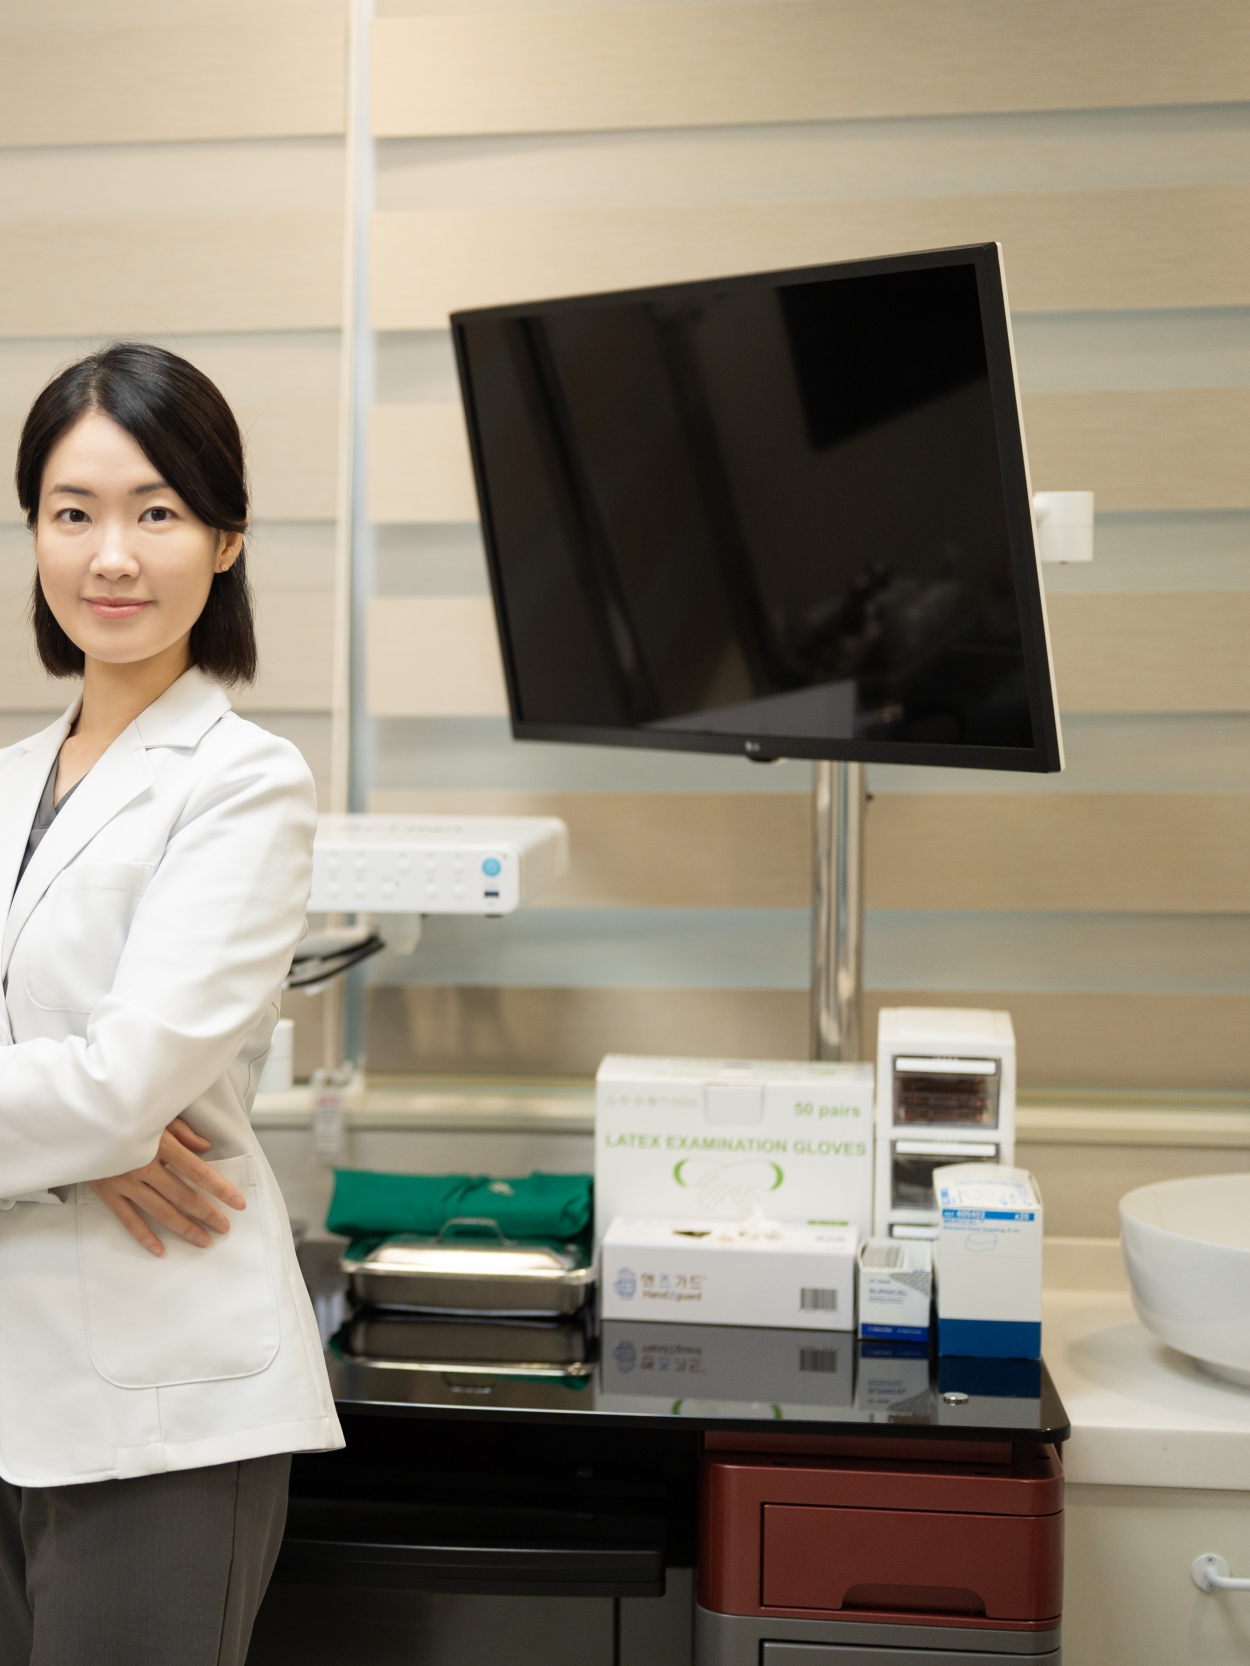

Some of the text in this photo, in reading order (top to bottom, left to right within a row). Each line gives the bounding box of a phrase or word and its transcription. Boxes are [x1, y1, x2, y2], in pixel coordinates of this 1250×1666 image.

[795, 1103, 861, 1119] 50 pairs
[605, 1133, 867, 1157] LATEX EXAMINATION GLOVES
